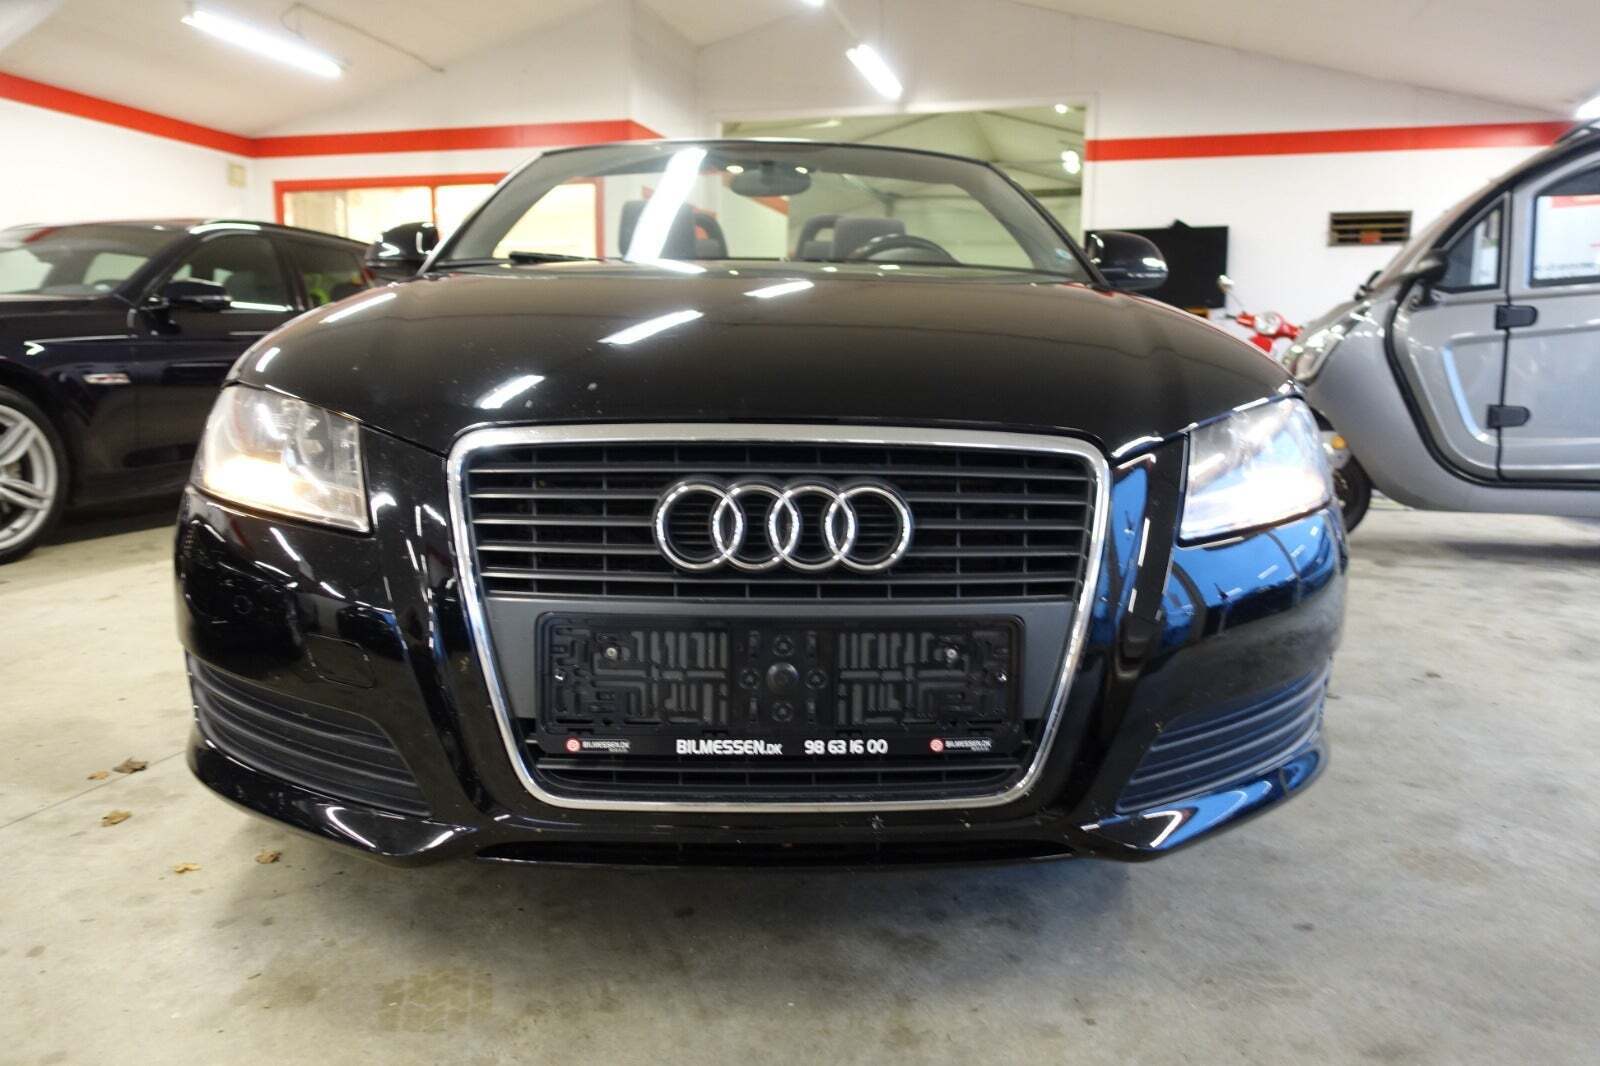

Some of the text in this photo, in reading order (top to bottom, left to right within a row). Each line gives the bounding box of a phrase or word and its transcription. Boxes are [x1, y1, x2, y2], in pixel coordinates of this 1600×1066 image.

[676, 738, 889, 754] BILMESSEN.DK 98 63 16 00
